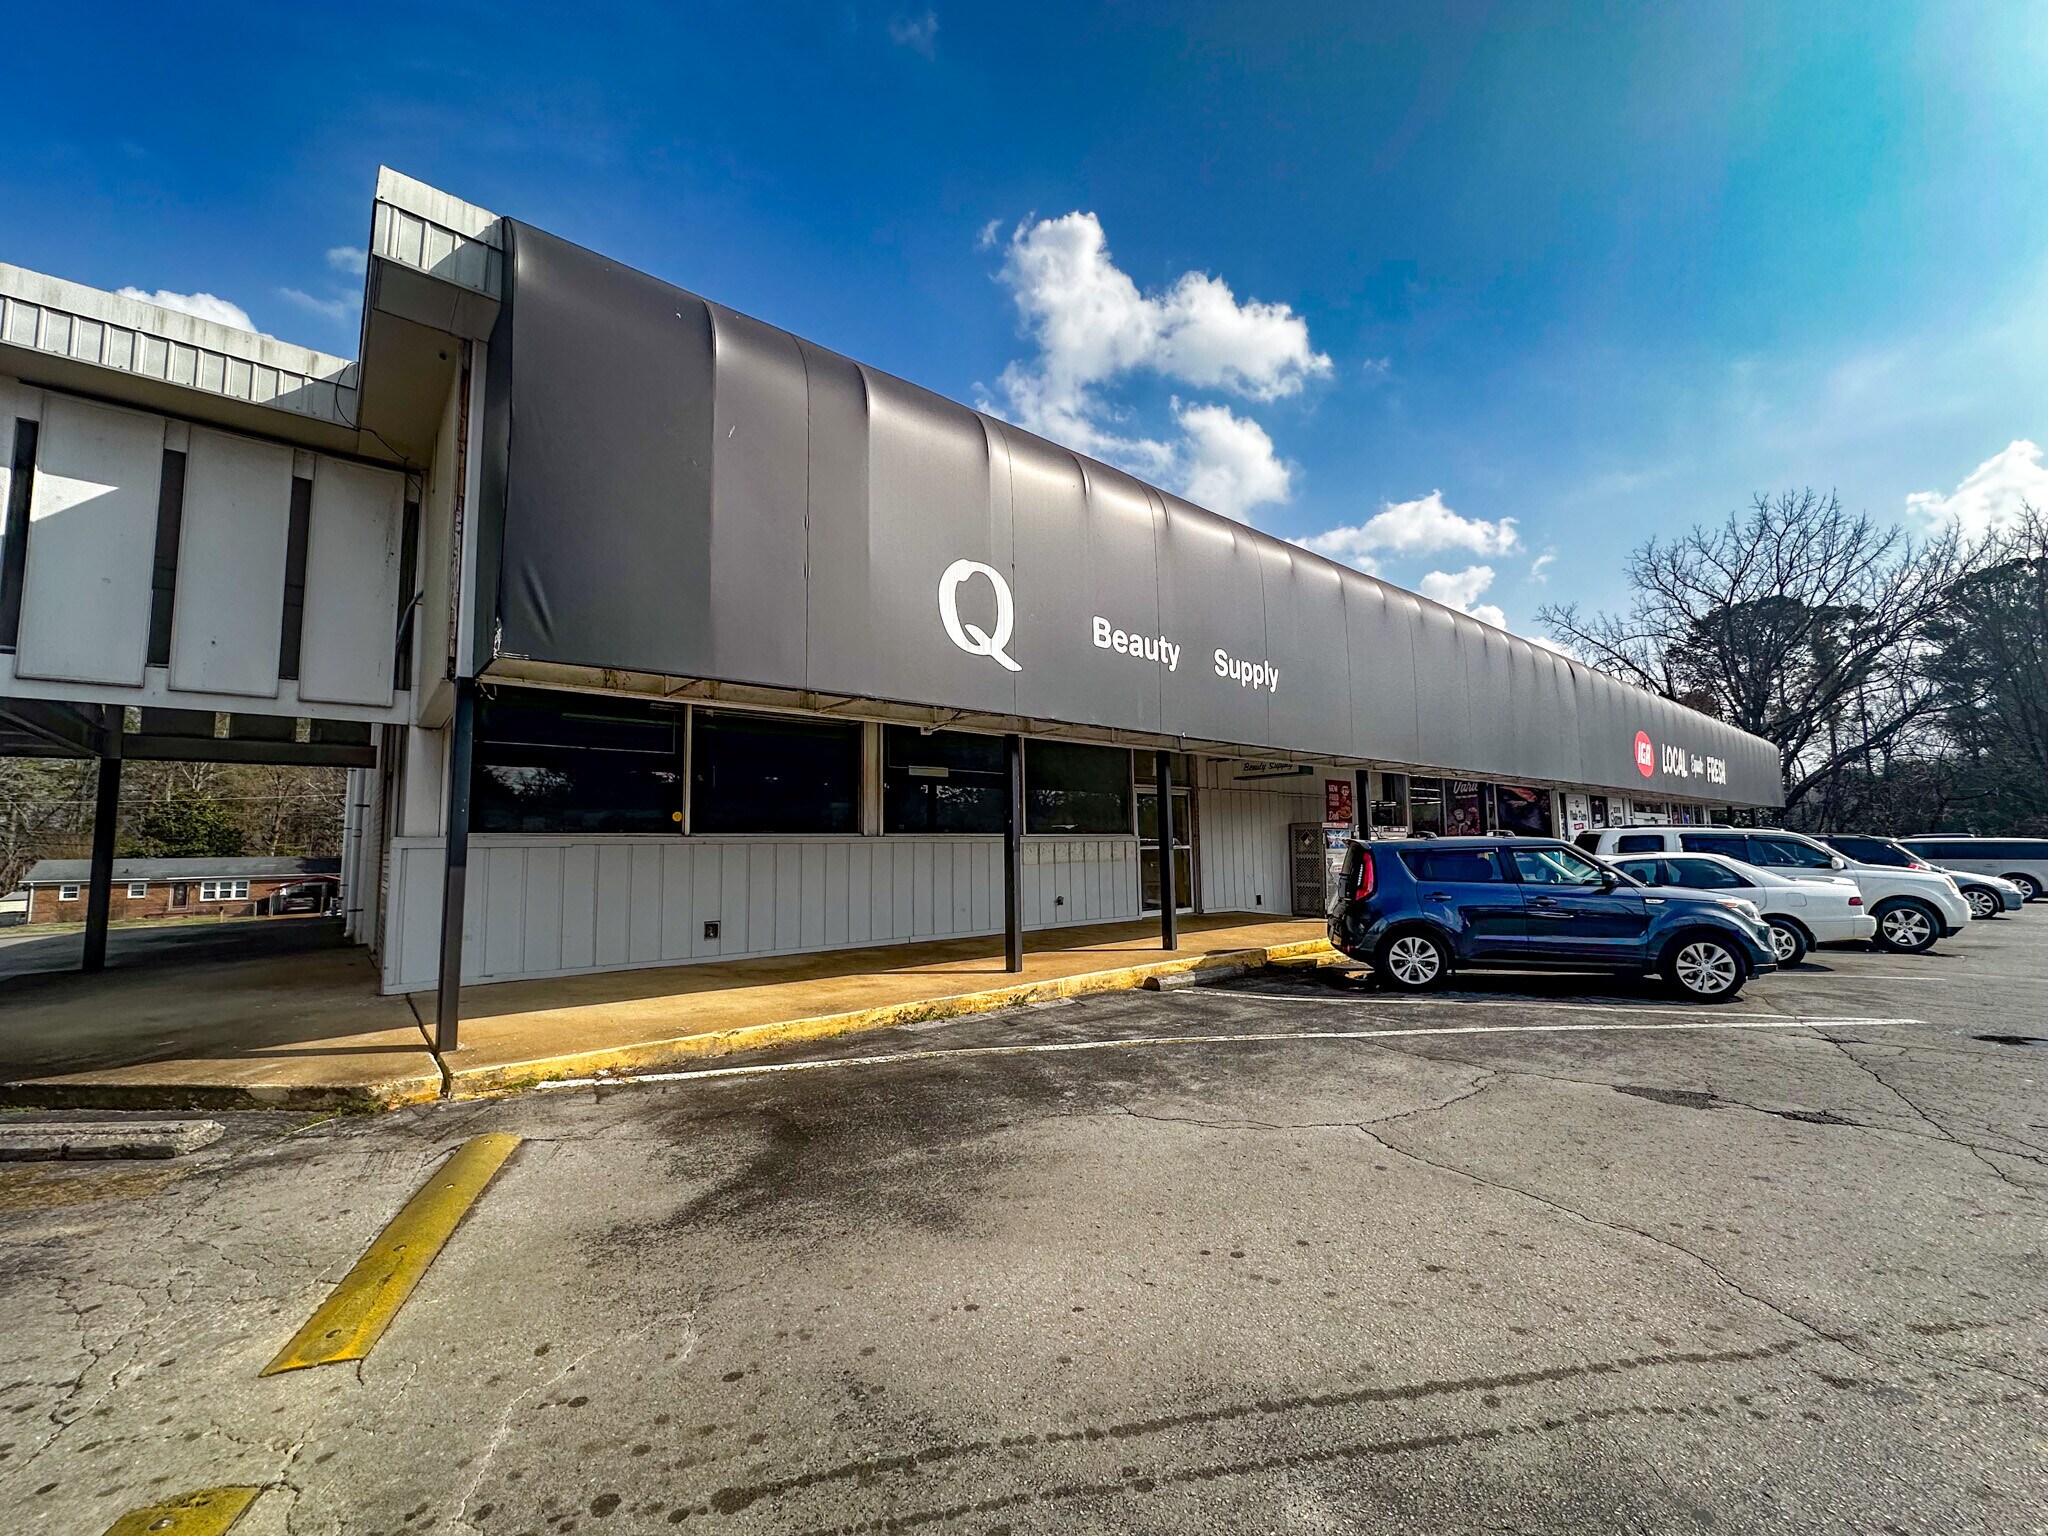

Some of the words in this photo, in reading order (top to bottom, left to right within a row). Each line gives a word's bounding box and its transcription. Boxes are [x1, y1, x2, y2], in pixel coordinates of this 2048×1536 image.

[938, 558, 1023, 672] Q
[1092, 615, 1181, 672] Beauty
[1213, 648, 1279, 693] Supply
[1638, 741, 1651, 766] IGA
[1662, 743, 1688, 778] LOCAL
